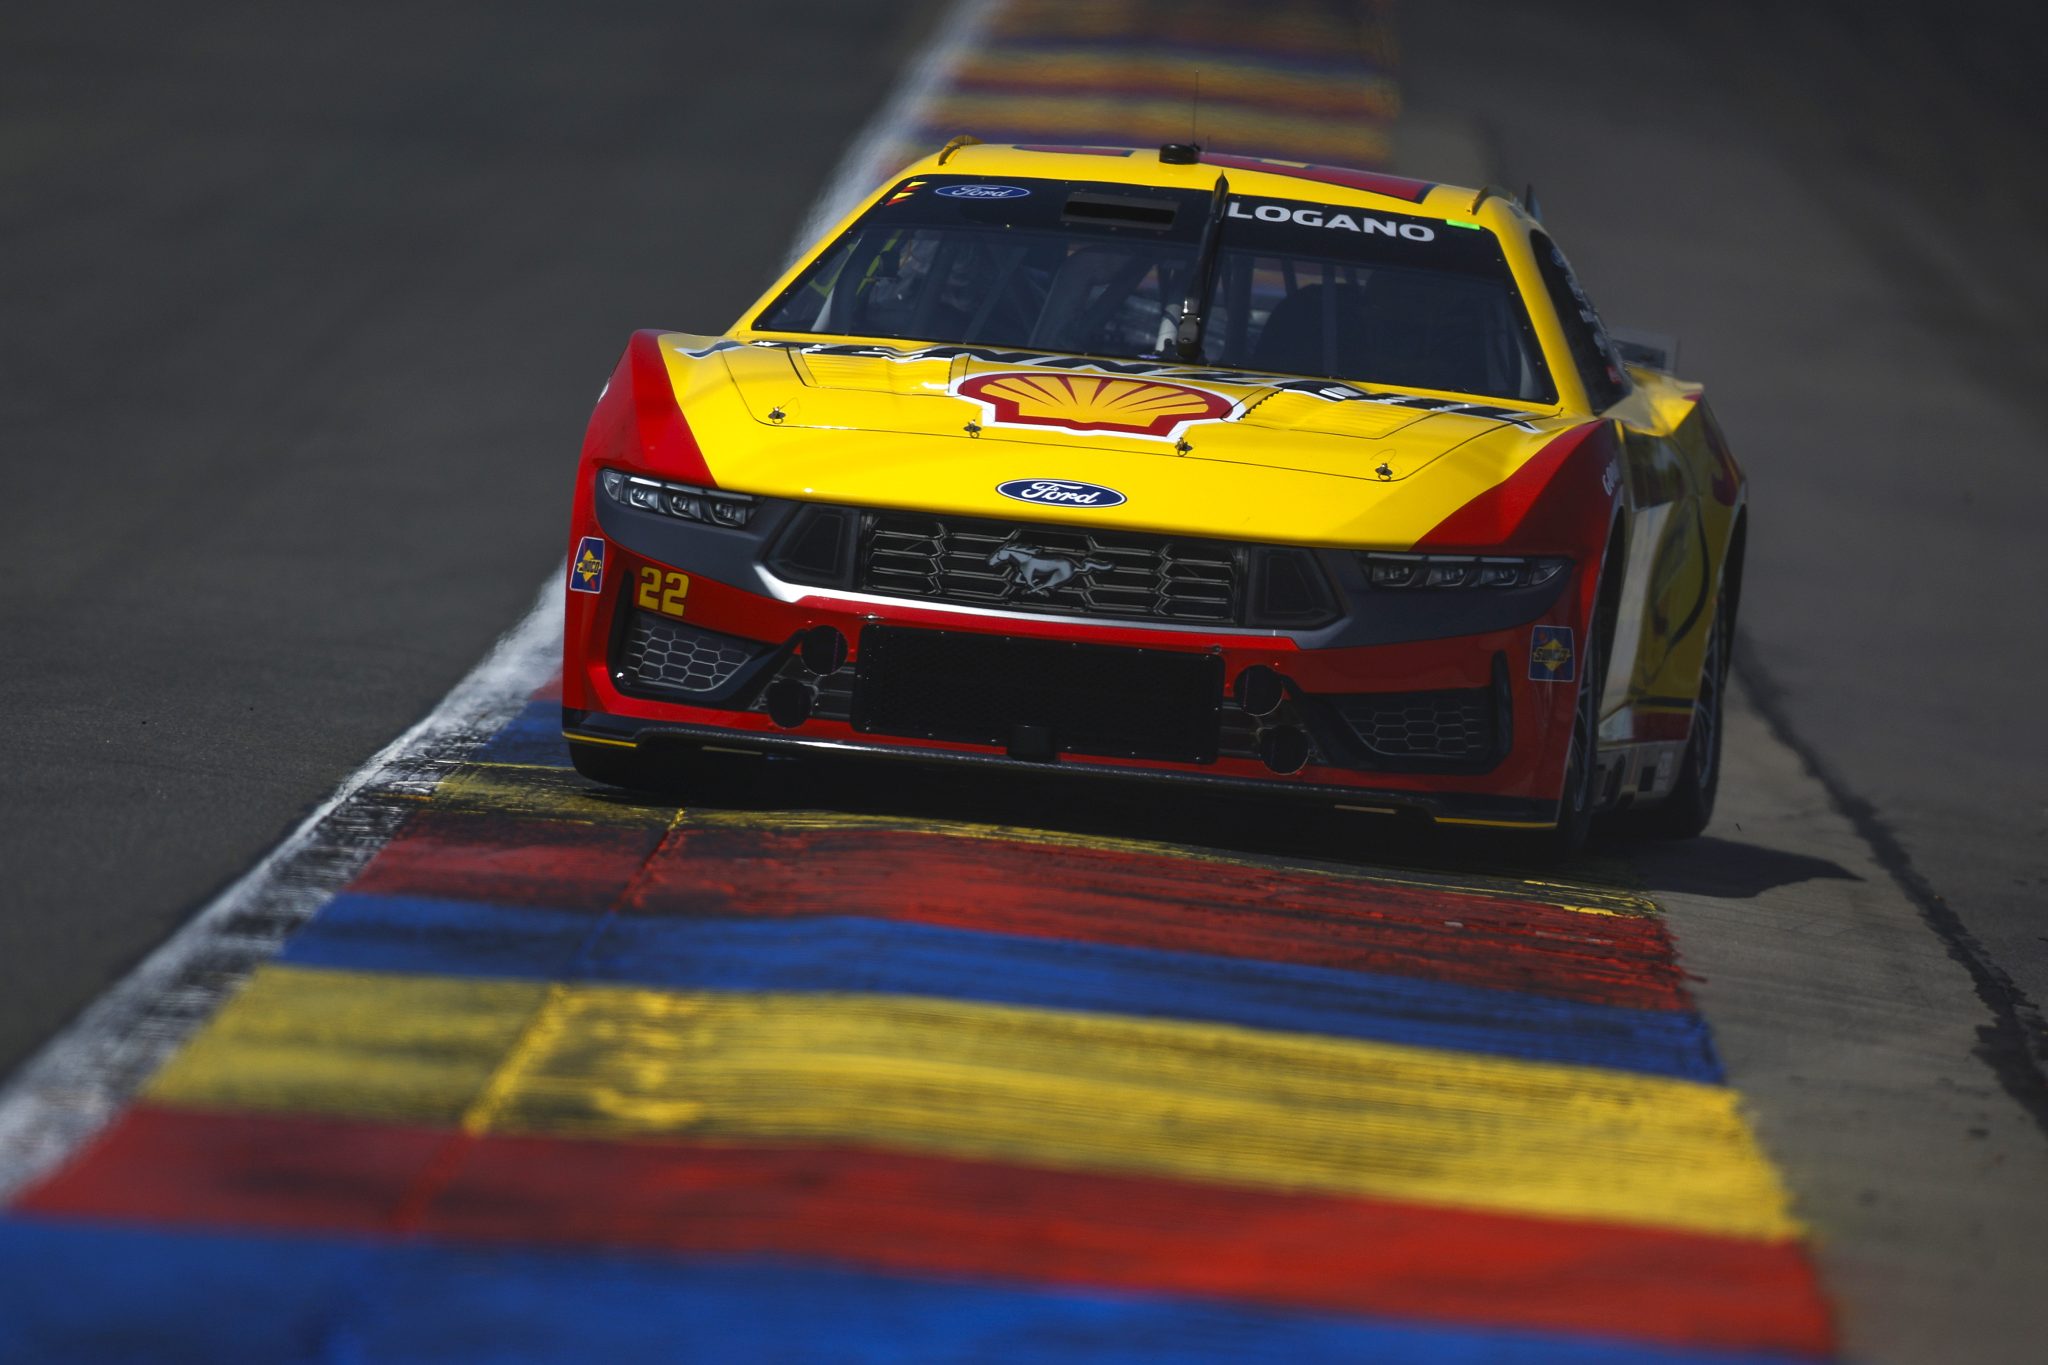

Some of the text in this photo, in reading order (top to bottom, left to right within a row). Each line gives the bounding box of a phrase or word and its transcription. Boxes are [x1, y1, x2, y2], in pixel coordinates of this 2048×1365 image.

[951, 185, 1013, 197] Ford
[1227, 201, 1435, 242] LOGANO
[1021, 481, 1101, 504] Ford
[638, 566, 690, 617] 22
